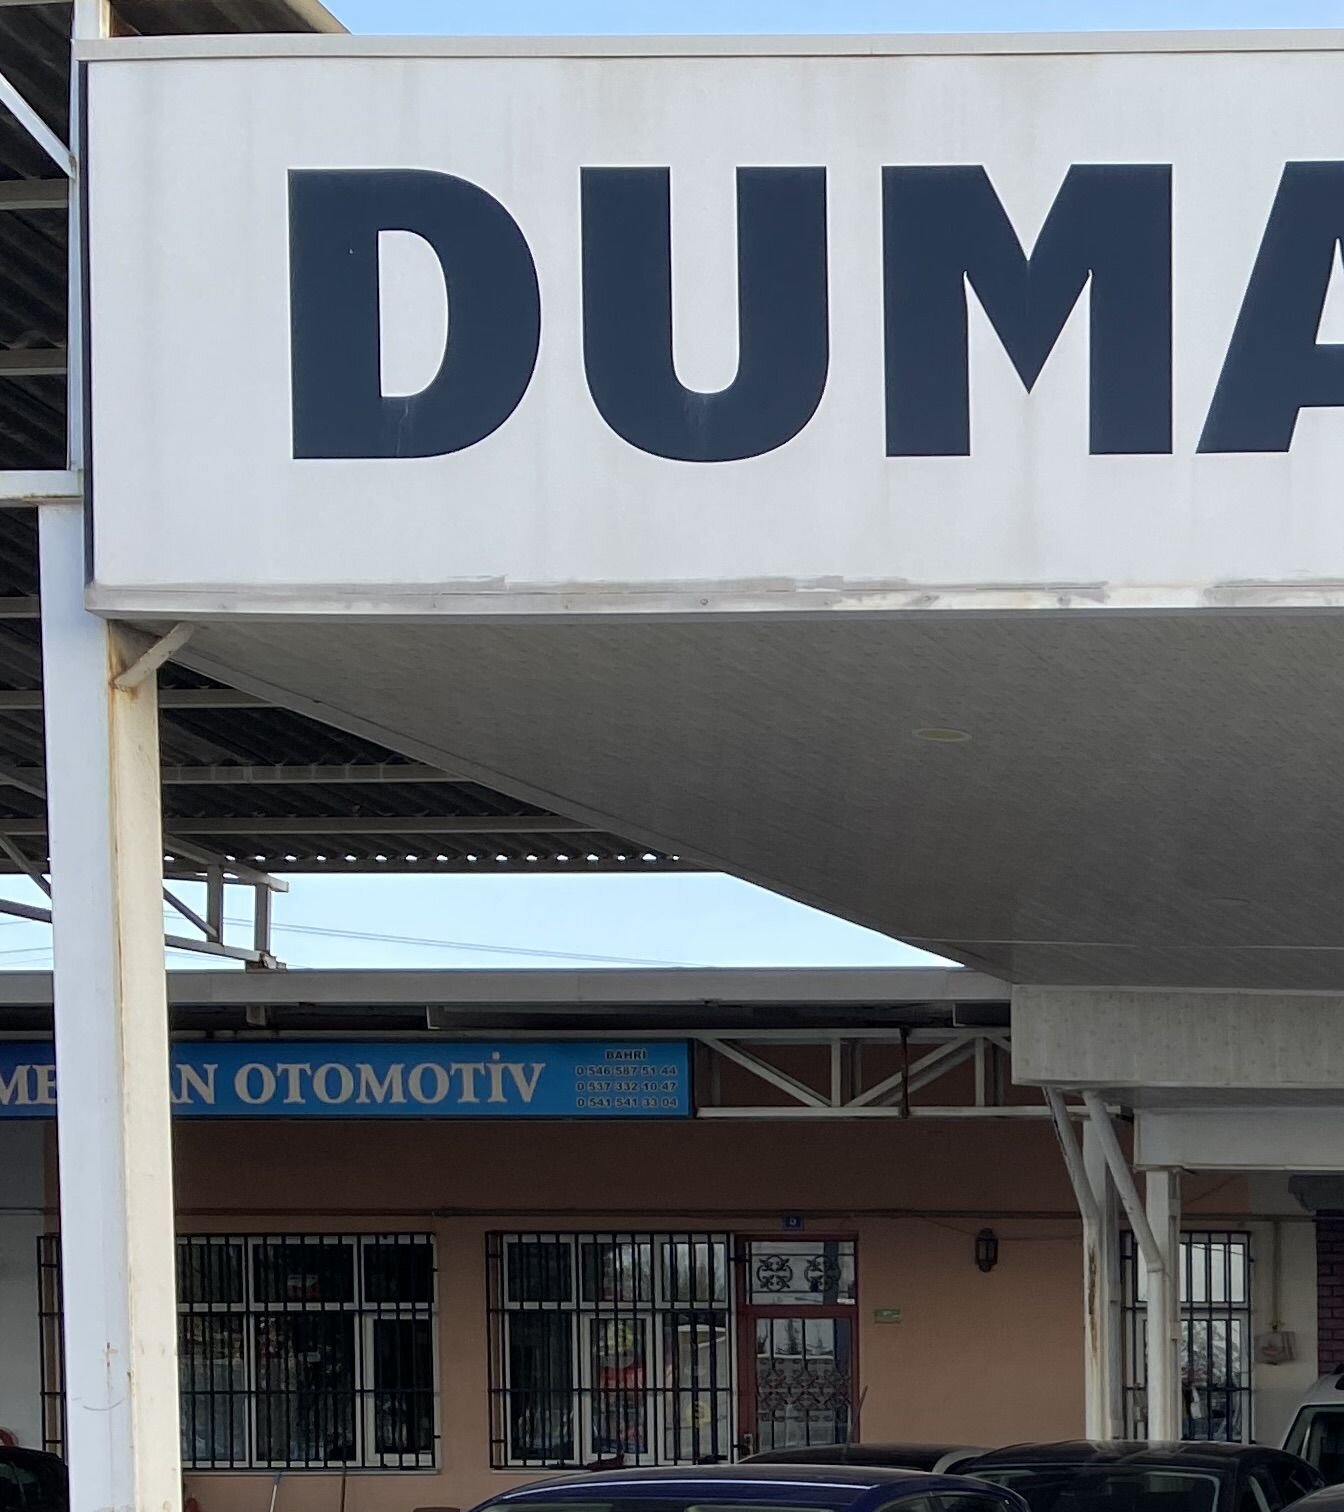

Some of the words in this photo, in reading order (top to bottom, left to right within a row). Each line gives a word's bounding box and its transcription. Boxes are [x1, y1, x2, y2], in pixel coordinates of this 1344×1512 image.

[575, 1065, 584, 1076] 0
[234, 1051, 546, 1105] OTOMOTİV
[576, 1081, 584, 1092] 0
[576, 1097, 585, 1108] 0
